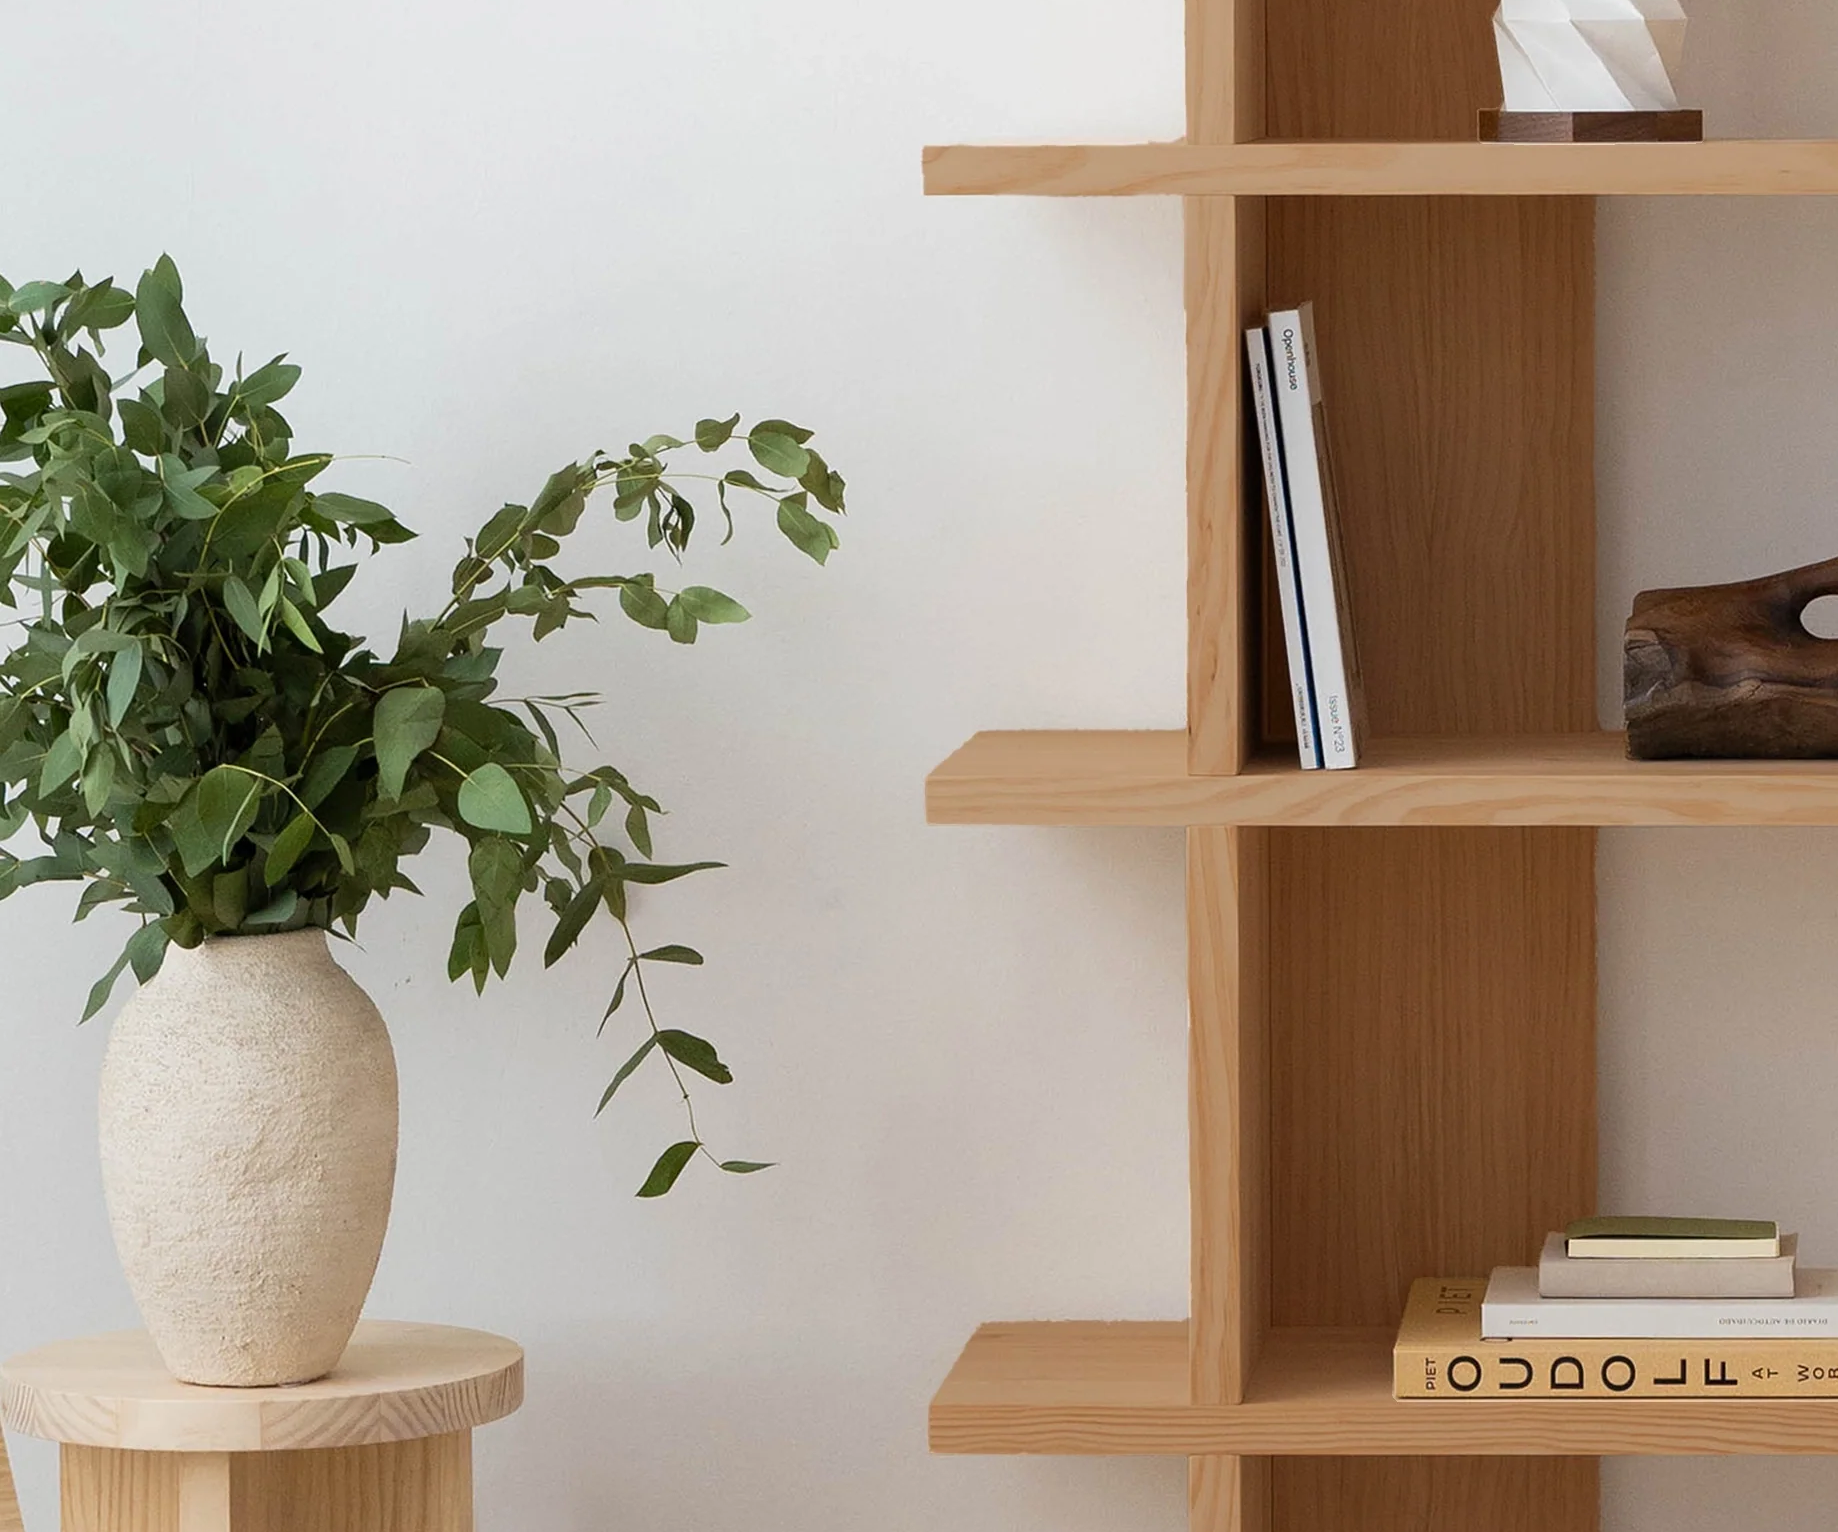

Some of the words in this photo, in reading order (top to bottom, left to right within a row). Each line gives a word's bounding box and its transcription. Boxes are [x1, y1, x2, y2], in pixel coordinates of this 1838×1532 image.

[1282, 328, 1298, 391] Openhouse
[1329, 695, 1340, 725] Issue
[1425, 1357, 1437, 1390] PIET
[1447, 1355, 1738, 1392] OUDOLF
[1752, 1368, 1779, 1379] AT
